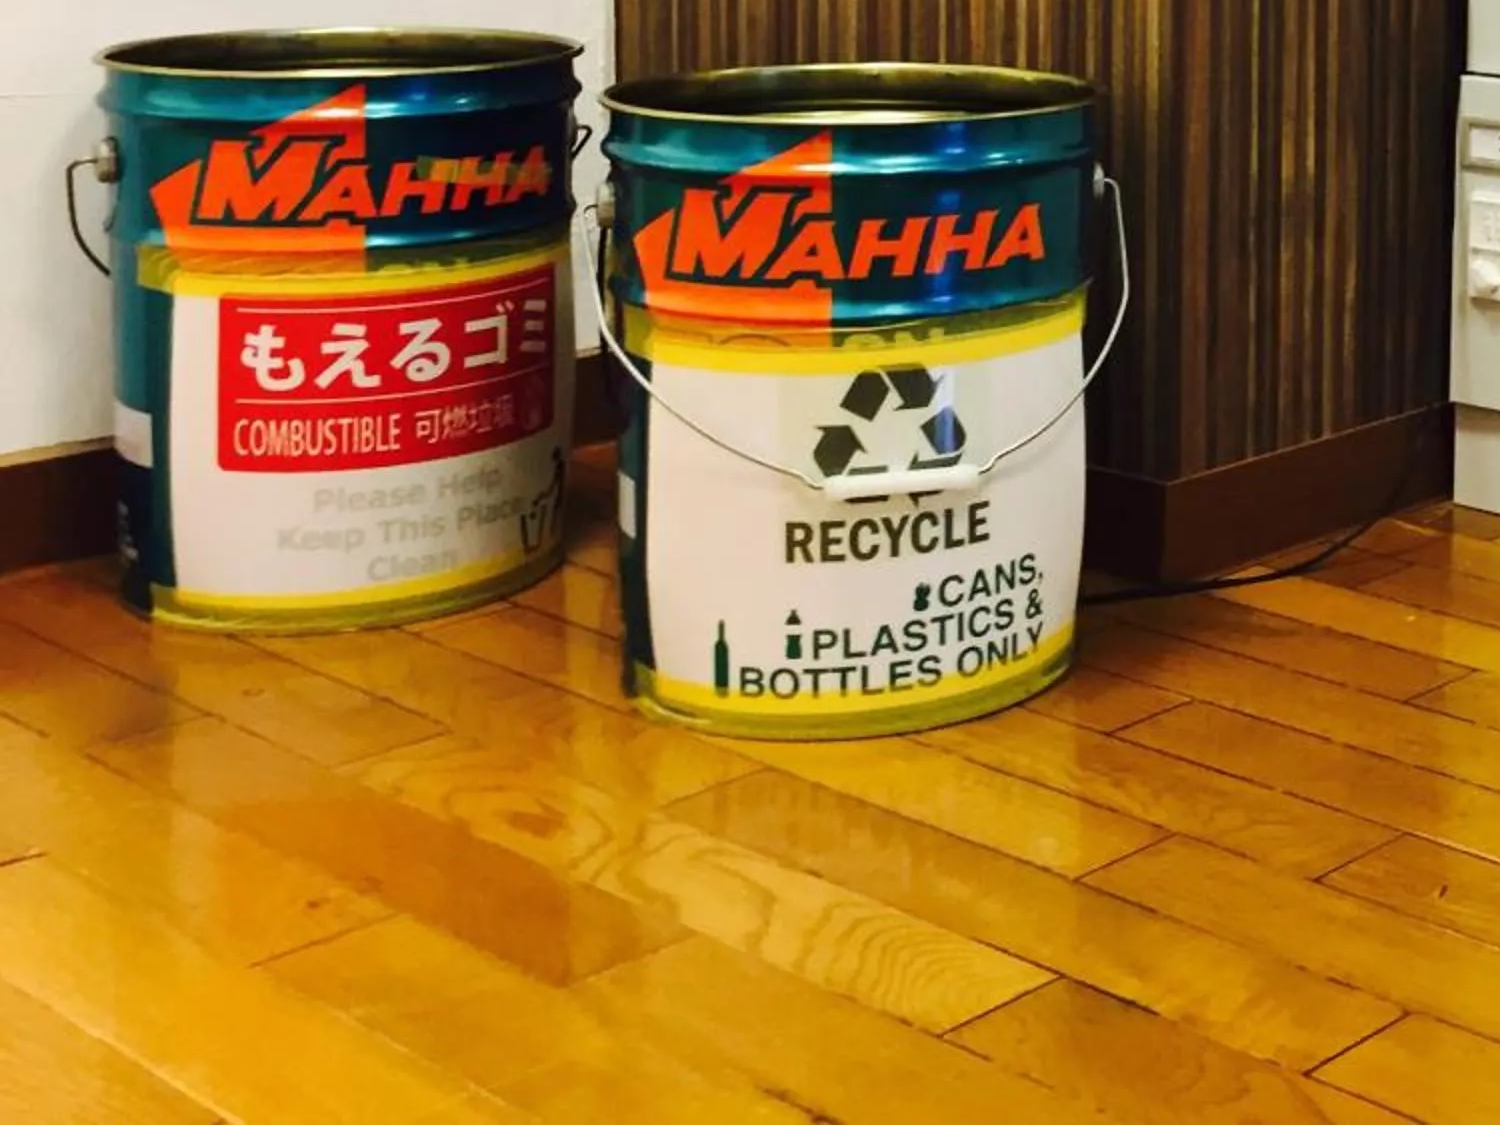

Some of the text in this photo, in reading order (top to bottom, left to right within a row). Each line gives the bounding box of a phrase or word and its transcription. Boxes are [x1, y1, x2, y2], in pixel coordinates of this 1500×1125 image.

[672, 188, 1046, 279] MAHHA
[240, 298, 548, 392] もえるゴミ
[233, 413, 401, 457] COMBUSTIBLE
[313, 464, 503, 512] Please Help
[277, 525, 366, 554] Keep
[379, 513, 447, 544] This
[785, 500, 990, 564] RECYCLE
[366, 550, 460, 581] Clean
[938, 552, 1044, 608] CANS,
[812, 588, 1044, 660] PLASTICS &
[739, 621, 1044, 699] BOTTLES ONLY
